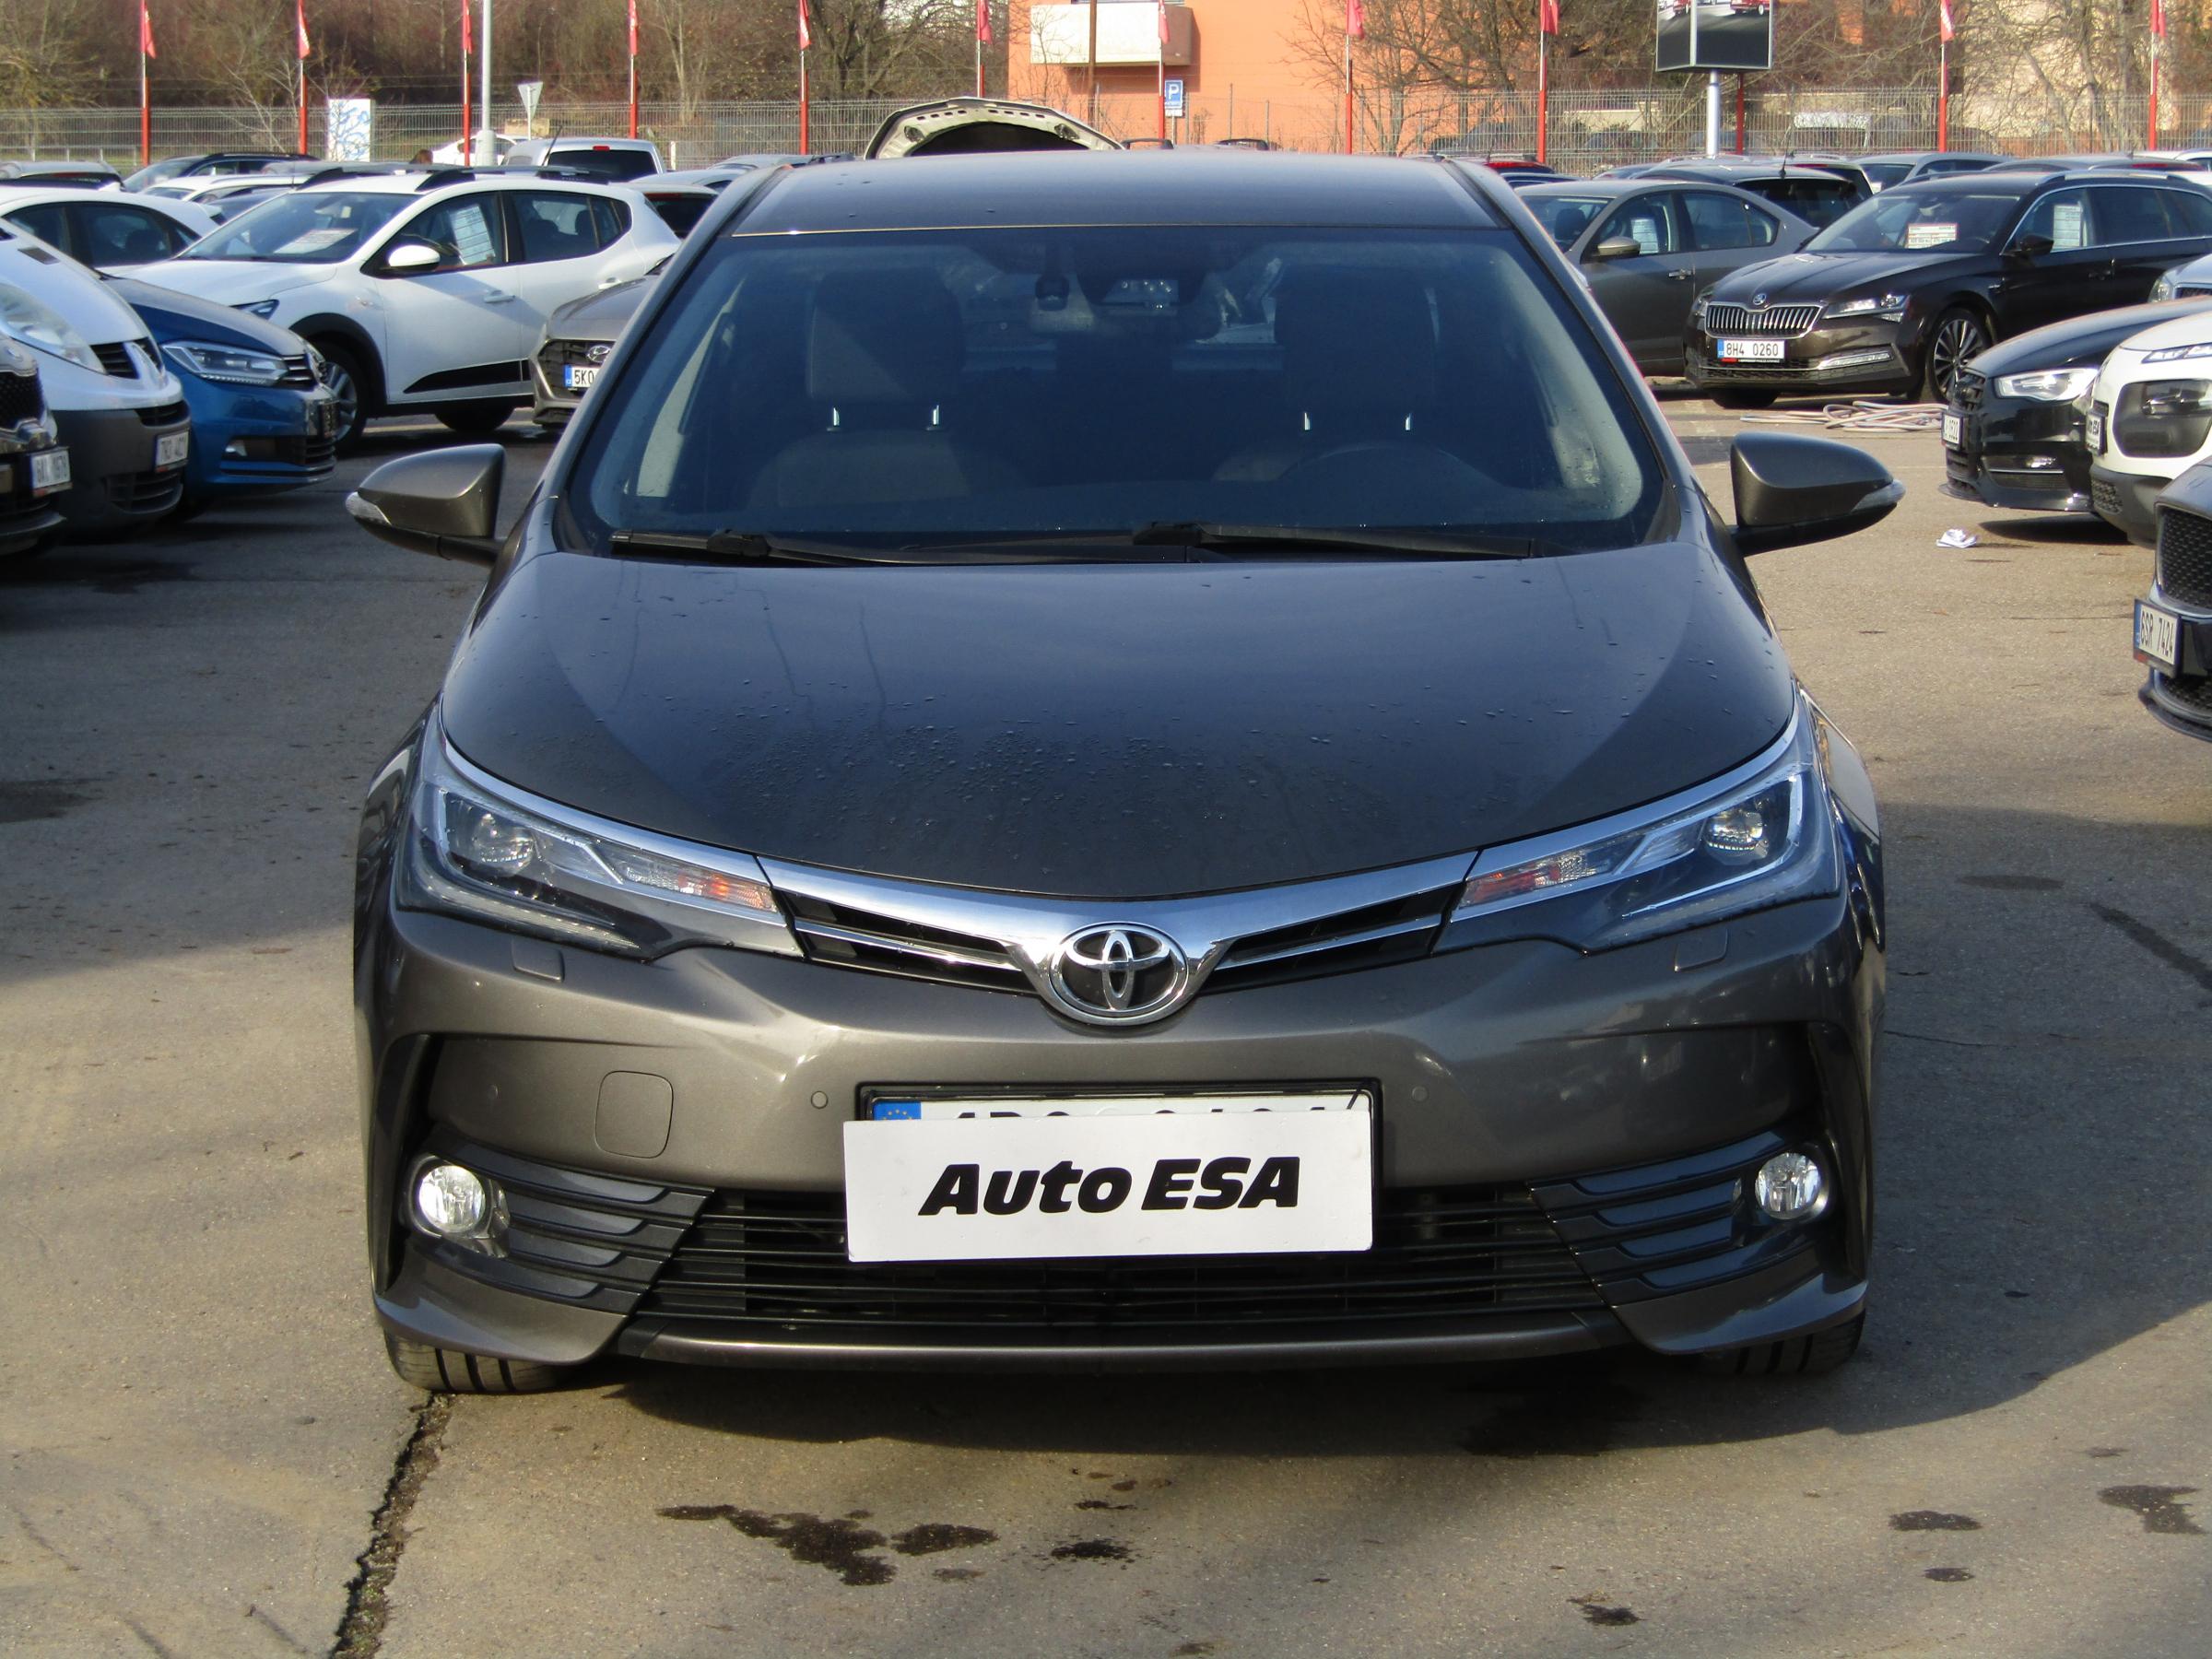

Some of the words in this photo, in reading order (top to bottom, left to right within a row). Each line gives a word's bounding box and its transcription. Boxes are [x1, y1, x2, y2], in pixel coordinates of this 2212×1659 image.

[1169, 83, 1180, 100] P
[1726, 343, 1745, 356] 8H4
[1752, 343, 1779, 357] 0260
[918, 1159, 1133, 1217] Auto
[1140, 1155, 1300, 1211] ESA
